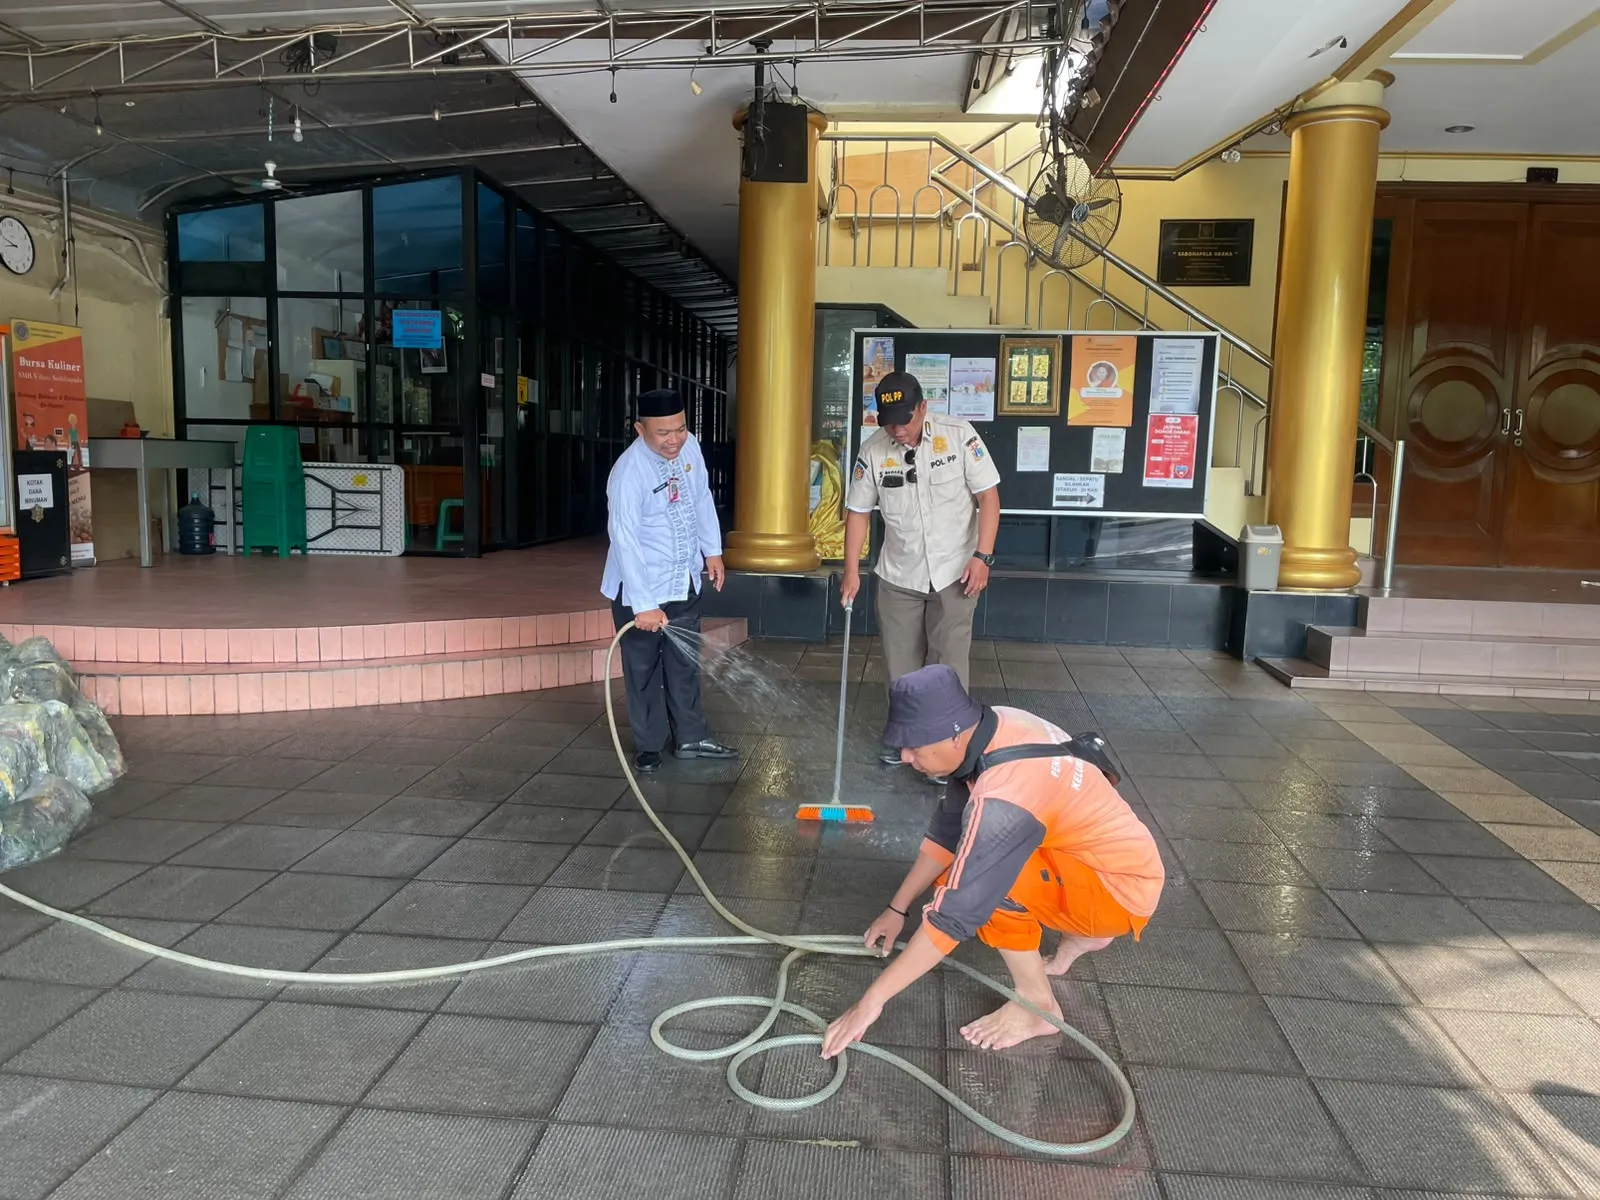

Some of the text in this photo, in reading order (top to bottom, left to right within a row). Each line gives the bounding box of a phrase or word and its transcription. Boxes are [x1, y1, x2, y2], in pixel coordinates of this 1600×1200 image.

[19, 356, 81, 372] Bursa Kuliner
[881, 392, 894, 404] POL
[894, 391, 902, 402] PP
[930, 454, 957, 469] POL PP
